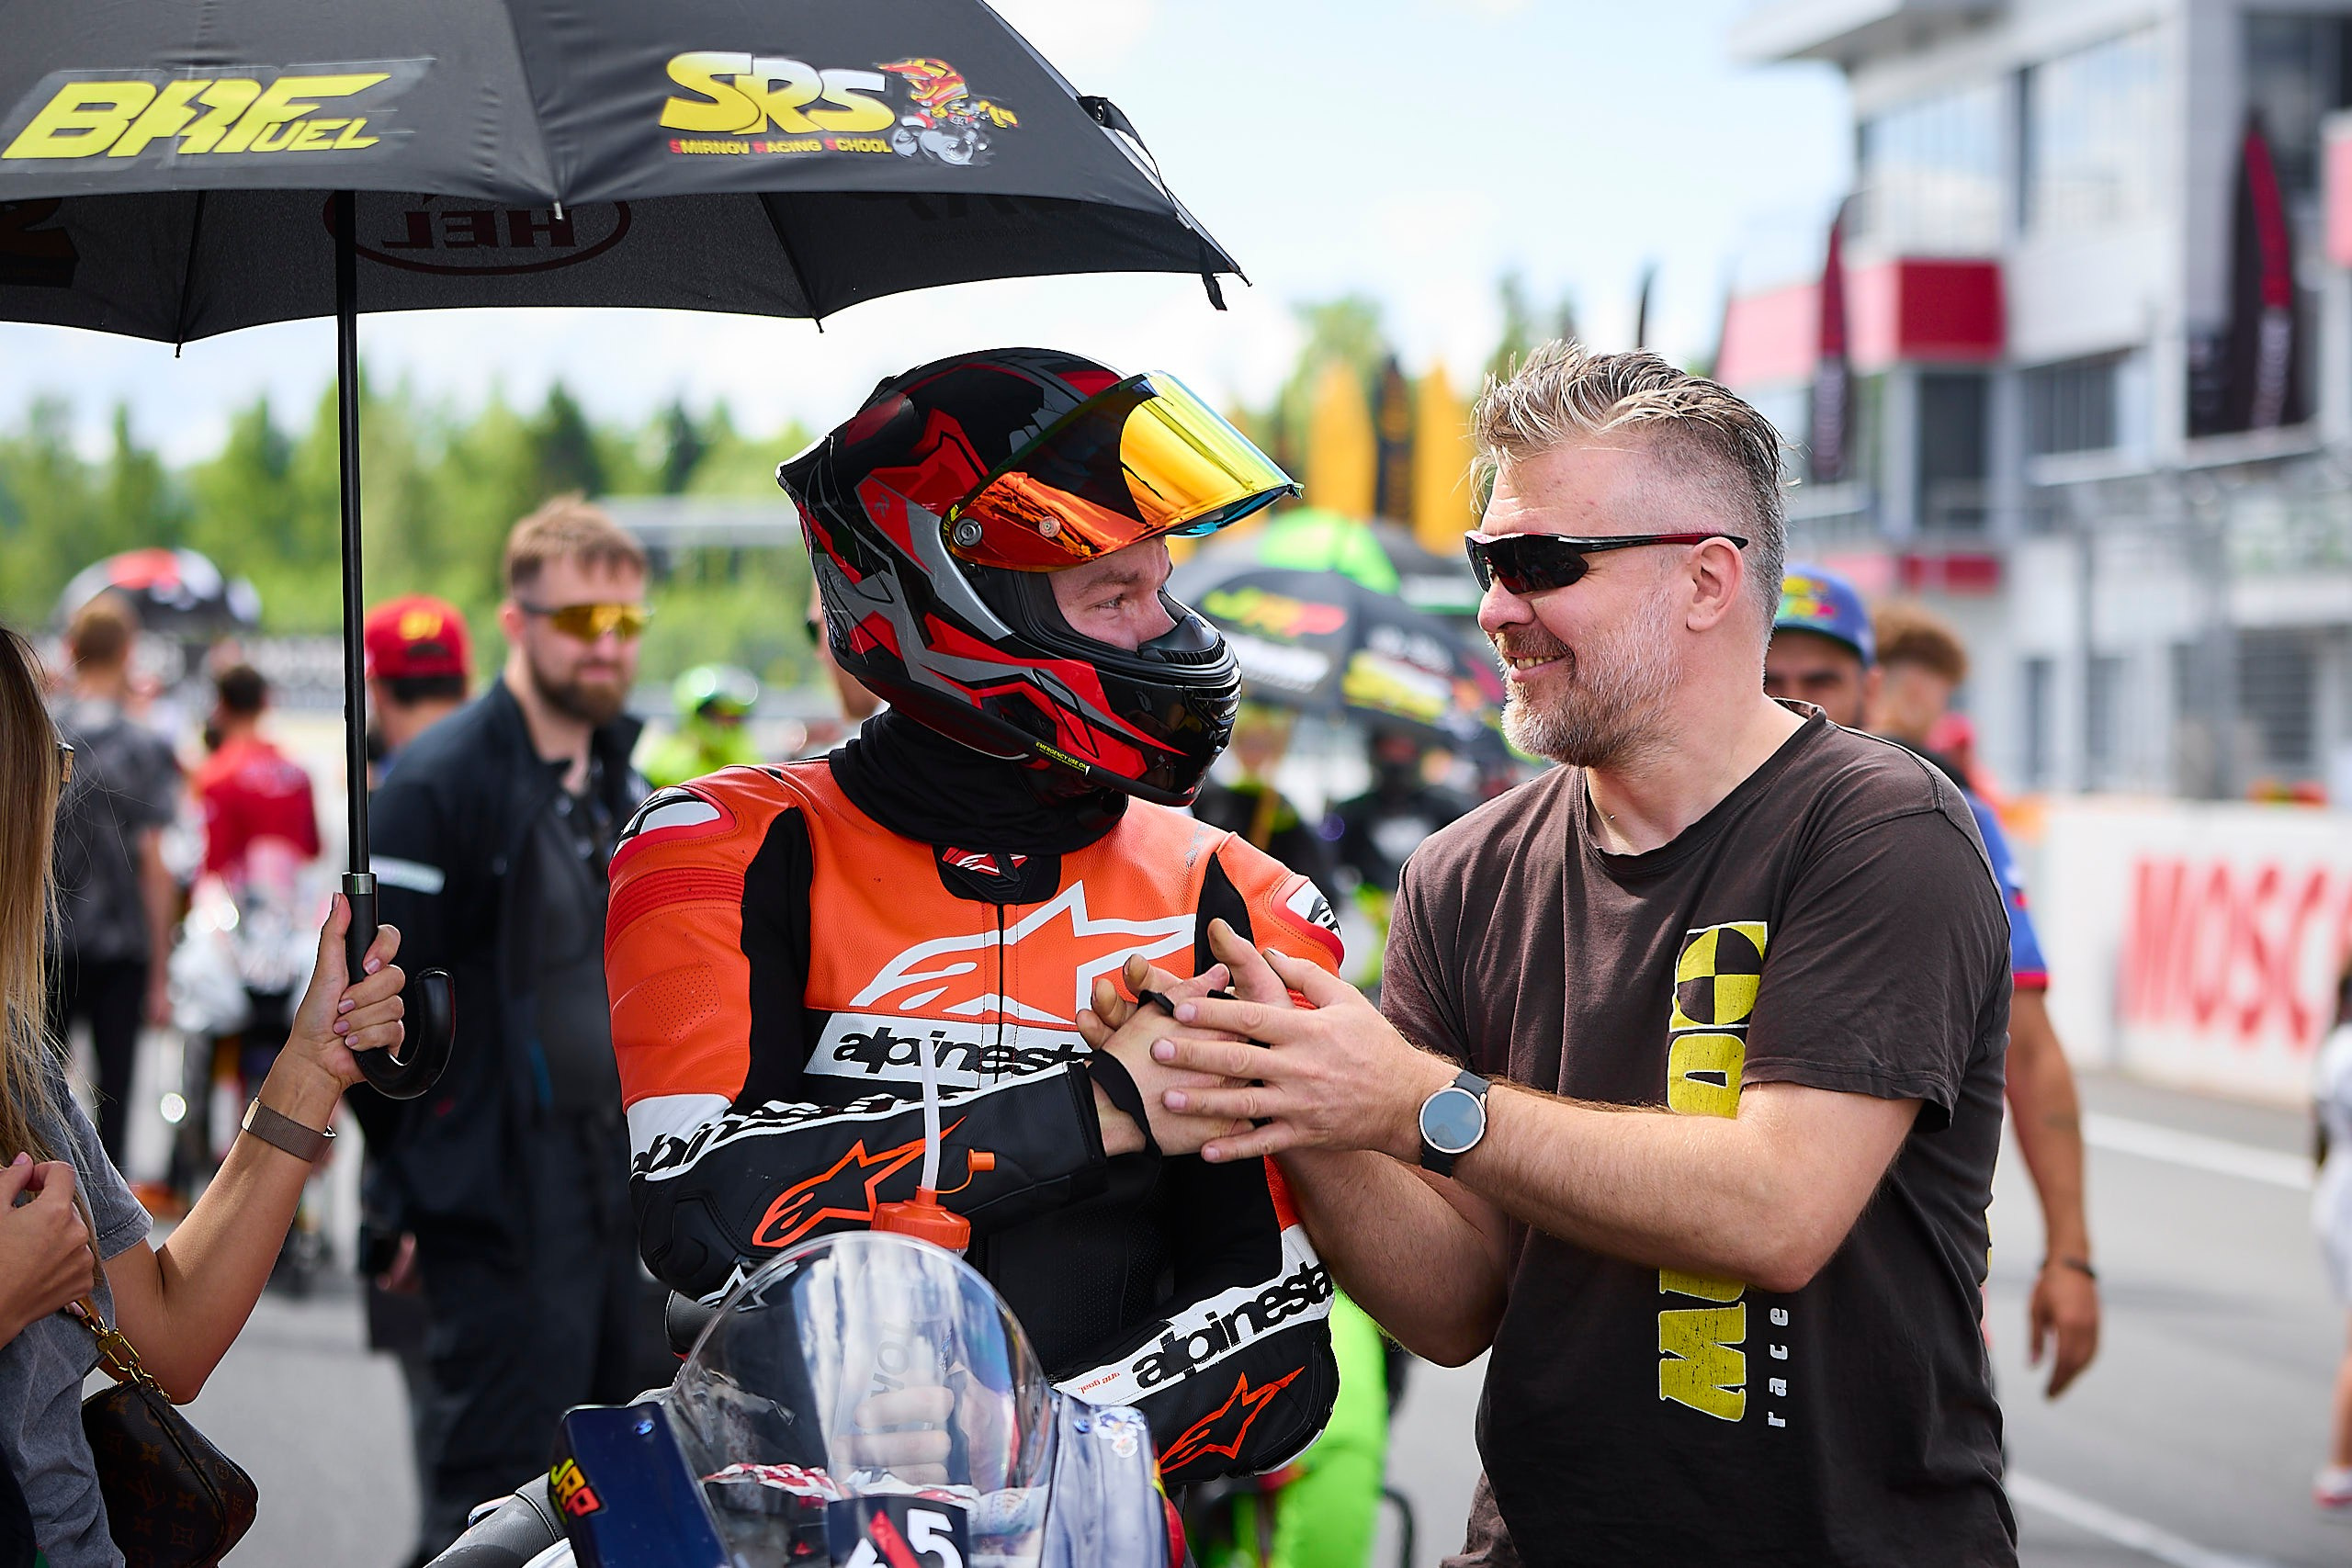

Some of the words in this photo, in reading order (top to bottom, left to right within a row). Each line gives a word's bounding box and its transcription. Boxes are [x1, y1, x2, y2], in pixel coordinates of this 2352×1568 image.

[659, 51, 896, 135] SRS
[669, 139, 750, 154] SMIRNOV
[752, 139, 822, 154] RACING
[824, 138, 893, 153] SCHOOL
[1035, 741, 1069, 761] EMERGENCY
[2117, 854, 2352, 1052] MOSC
[832, 1026, 1093, 1077] alpinest
[1768, 1307, 1789, 1428] race
[550, 1459, 601, 1517] JRP
